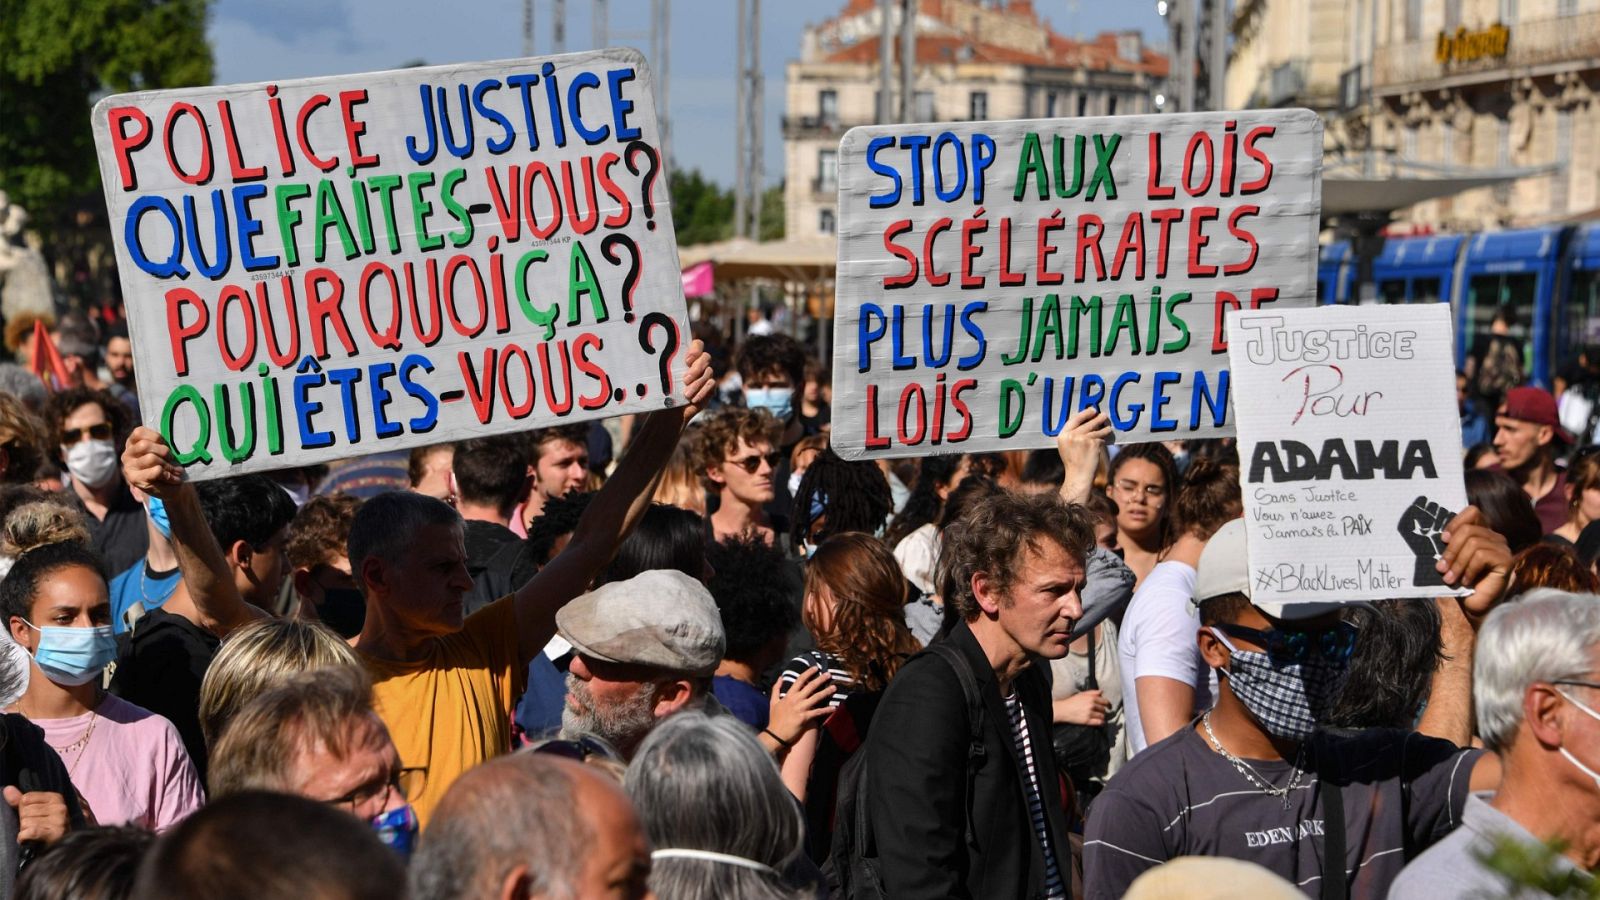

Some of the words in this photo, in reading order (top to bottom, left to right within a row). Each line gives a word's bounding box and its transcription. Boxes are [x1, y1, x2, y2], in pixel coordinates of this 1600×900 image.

[866, 131, 996, 208] STOP
[1013, 132, 1122, 201] AUX
[1147, 120, 1276, 200] LOIS
[883, 205, 1261, 290] SCÉLÉRATES
[858, 301, 988, 373] PLUS
[1000, 286, 1192, 366] JAMAIS
[1211, 287, 1280, 355] D
[864, 373, 978, 450] LOIS
[998, 370, 1231, 438] D'URGEN
[1282, 364, 1383, 426] Pour
[1248, 438, 1439, 483] ADAMA
[1254, 487, 1297, 506] Sans
[1300, 486, 1358, 502] Justice
[1258, 524, 1324, 540] Jamais
[1255, 558, 1406, 593] #BlackLivesMatter
[1245, 827, 1294, 847] EDEN
[1295, 820, 1324, 841] ARK
